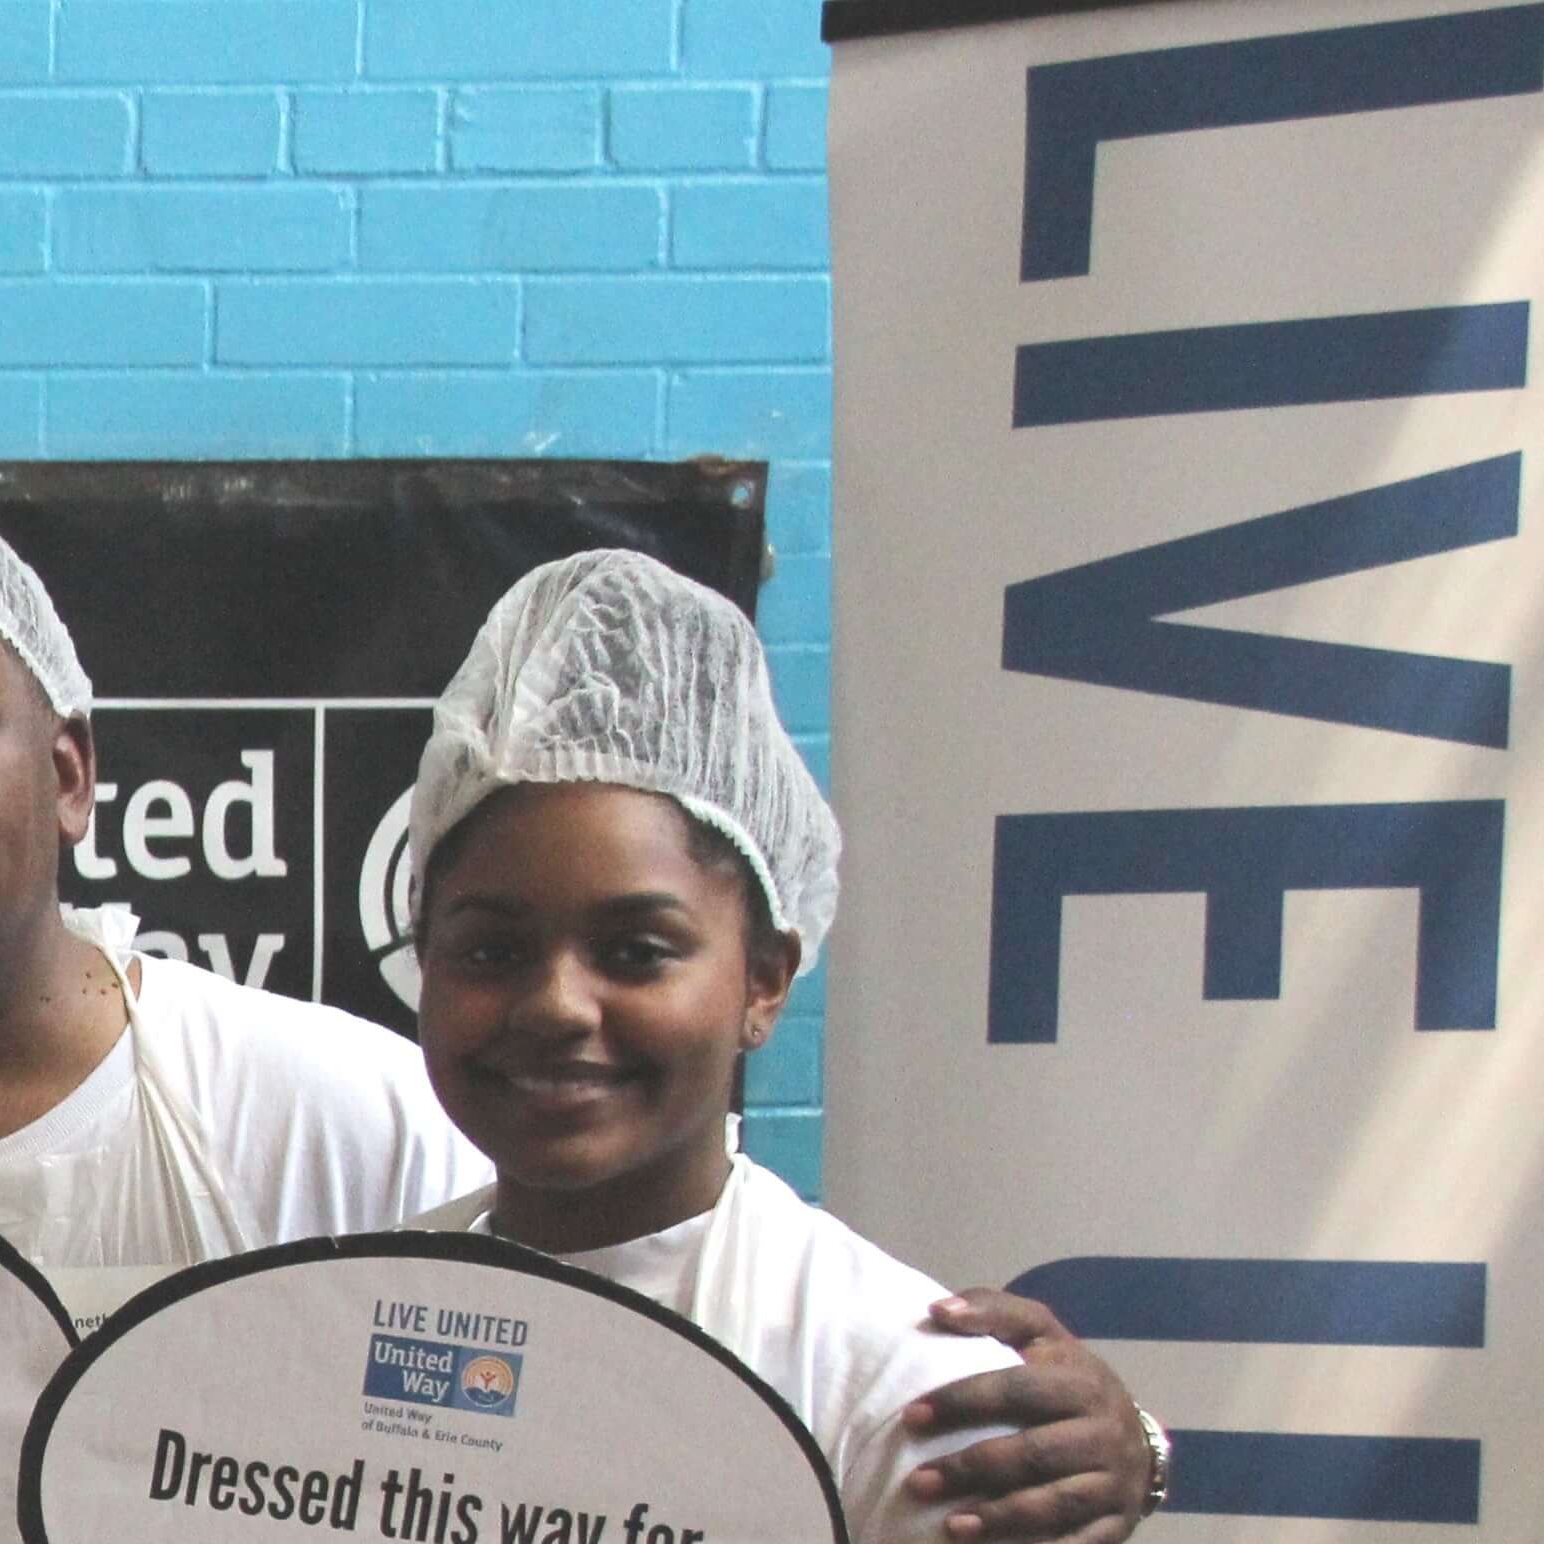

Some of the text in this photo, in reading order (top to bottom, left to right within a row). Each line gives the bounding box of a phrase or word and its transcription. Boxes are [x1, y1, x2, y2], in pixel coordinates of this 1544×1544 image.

[987, 4, 1544, 1045] LIVE
[373, 1299, 528, 1347] LIVE UNITED
[374, 1341, 454, 1374] United
[402, 1369, 450, 1402] Way
[364, 1402, 432, 1424] United Way
[362, 1419, 503, 1451] of Buffalo & Erie County
[149, 1429, 365, 1532] Dressed
